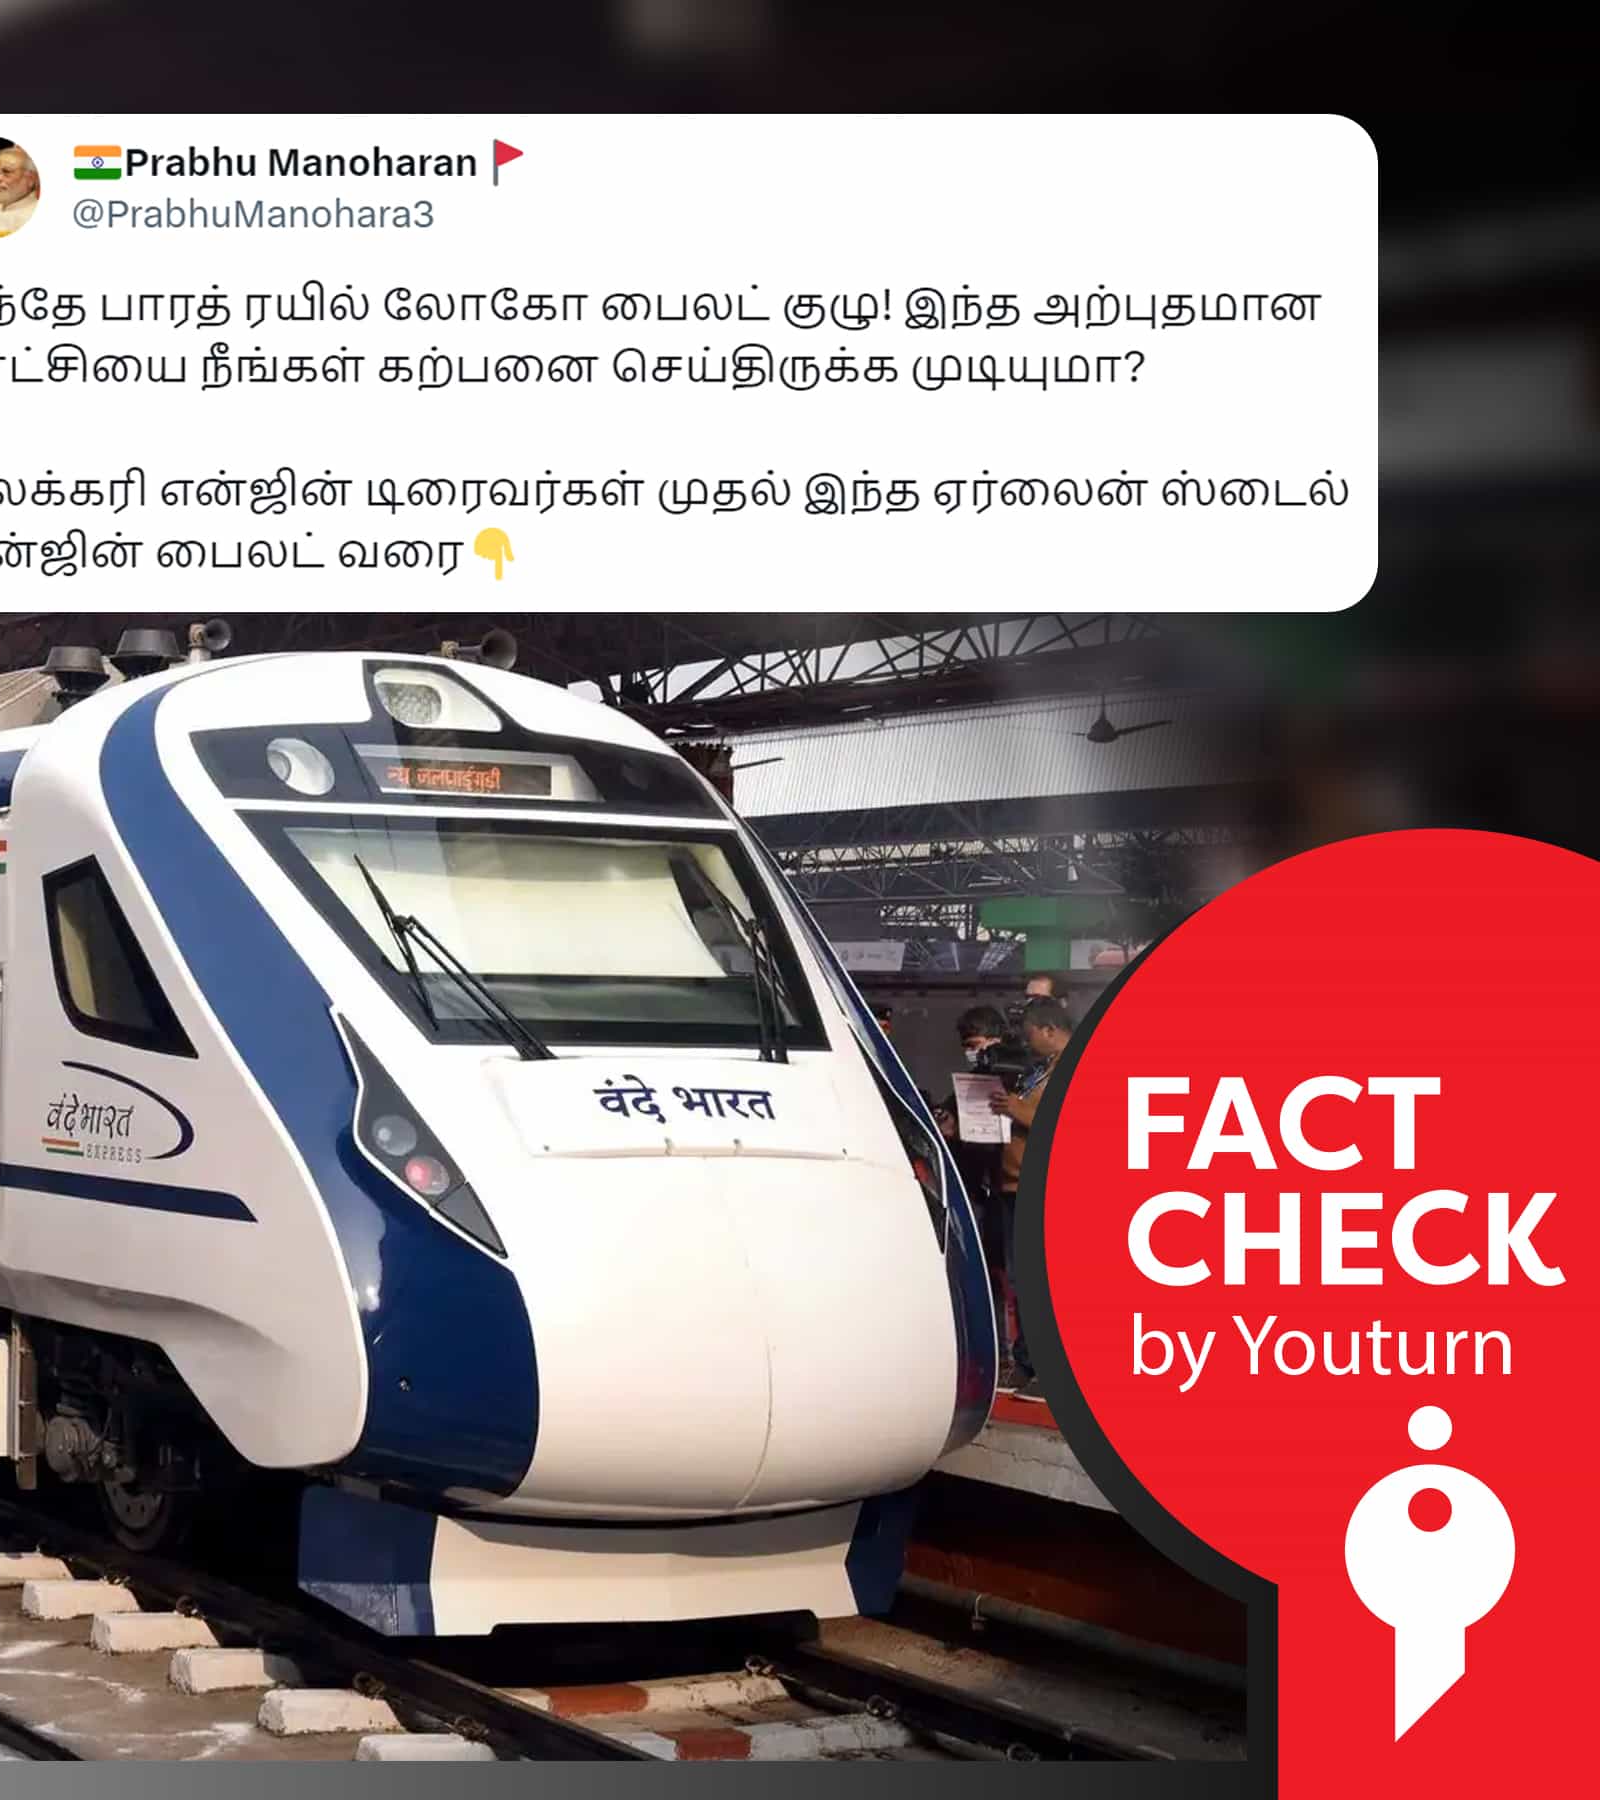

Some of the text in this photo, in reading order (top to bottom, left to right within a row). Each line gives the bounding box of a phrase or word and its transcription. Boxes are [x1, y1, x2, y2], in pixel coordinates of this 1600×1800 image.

[592, 1074, 776, 1124] वंदे भारत
[86, 1143, 142, 1164] EXPRESS
